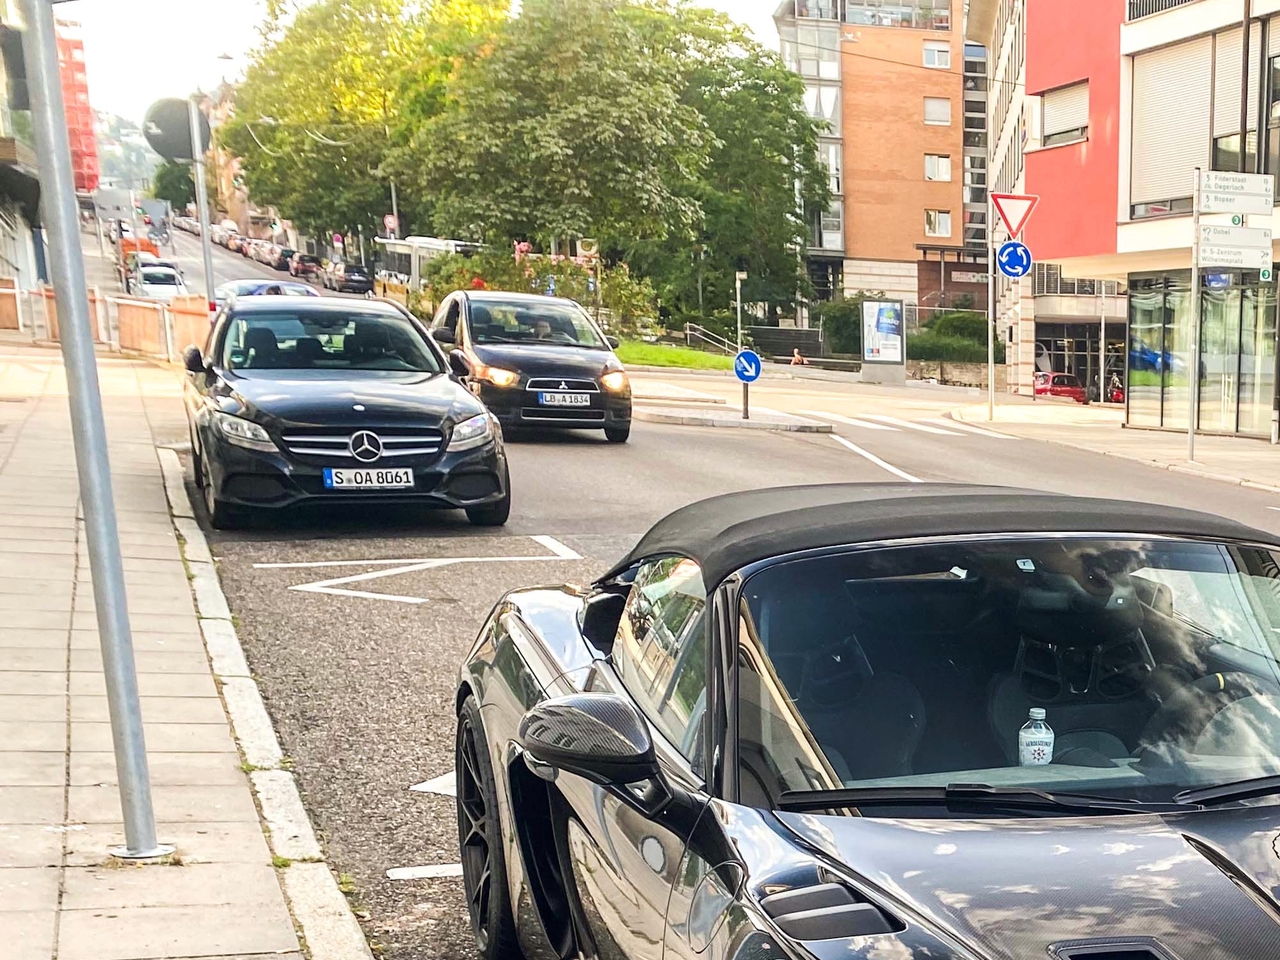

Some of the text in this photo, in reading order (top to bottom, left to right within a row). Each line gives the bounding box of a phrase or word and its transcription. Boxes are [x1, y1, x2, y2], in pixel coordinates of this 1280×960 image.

[1214, 174, 1247, 183] Filderstadt
[1214, 182, 1245, 191] Degerloch
[1213, 195, 1235, 203] Bopser
[1201, 255, 1244, 264] Wilhelmsplatz
[561, 395, 567, 403] A
[334, 471, 412, 485] S OA 8061
